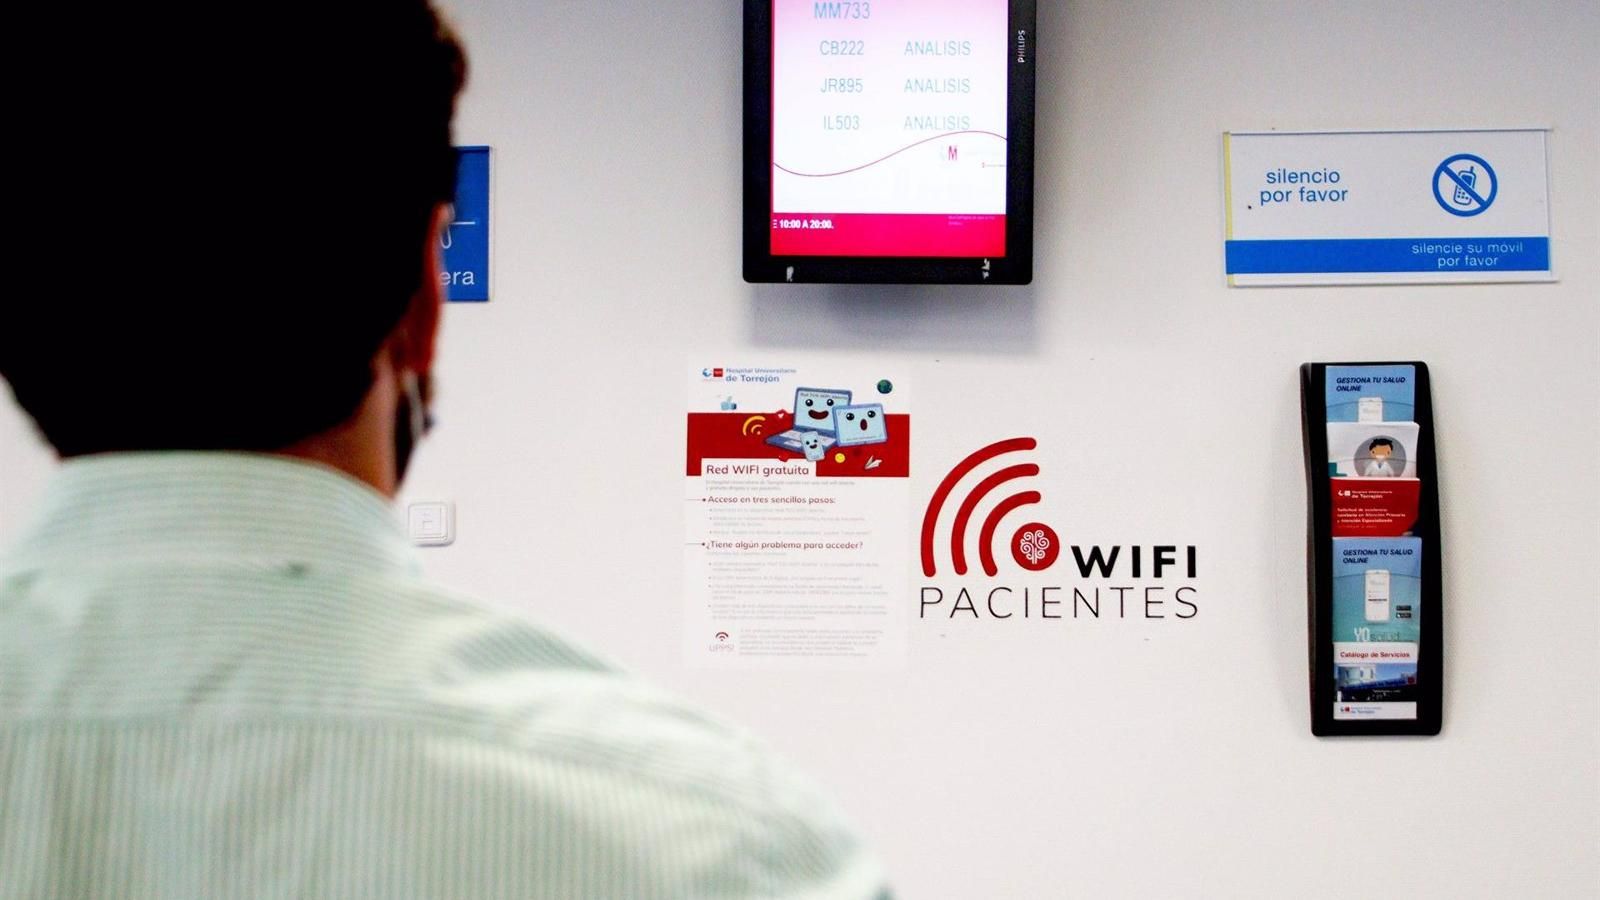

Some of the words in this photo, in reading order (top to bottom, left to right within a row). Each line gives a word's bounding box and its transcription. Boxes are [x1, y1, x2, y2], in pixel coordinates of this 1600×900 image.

[814, 2, 870, 19] MM733
[819, 40, 865, 56] CB222
[904, 40, 971, 56] ANALISIS
[1018, 29, 1026, 63] PHILIPS
[820, 78, 863, 94] JR895
[904, 78, 971, 94] ANALISIS
[823, 115, 860, 131] IL503
[904, 115, 970, 131] ANALISIS
[1266, 168, 1340, 185] silencio
[1260, 189, 1291, 206] por
[1299, 186, 1348, 202] favor
[780, 219, 801, 229] 10:00
[802, 219, 809, 229] A
[1411, 242, 1463, 255] silencie
[1467, 244, 1483, 253] su
[1488, 241, 1523, 254] móvil
[1437, 256, 1460, 268] por
[1465, 253, 1499, 266] favor
[440, 271, 475, 285] era
[706, 464, 731, 475] Red
[733, 464, 759, 475] WIFI
[763, 463, 809, 477] gratuita
[707, 495, 738, 504] Acceso
[753, 496, 769, 504] tres
[771, 495, 807, 504] sencillos
[808, 496, 836, 505] pasos:
[706, 541, 733, 551] ¿Tiene
[735, 541, 759, 551] algún
[761, 541, 801, 551] problema
[803, 542, 824, 551] para
[826, 541, 863, 550] acceder?
[1070, 545, 1197, 578] WIFI
[920, 587, 1199, 619] PACIENTES
[1380, 650, 1411, 658] Servicios
